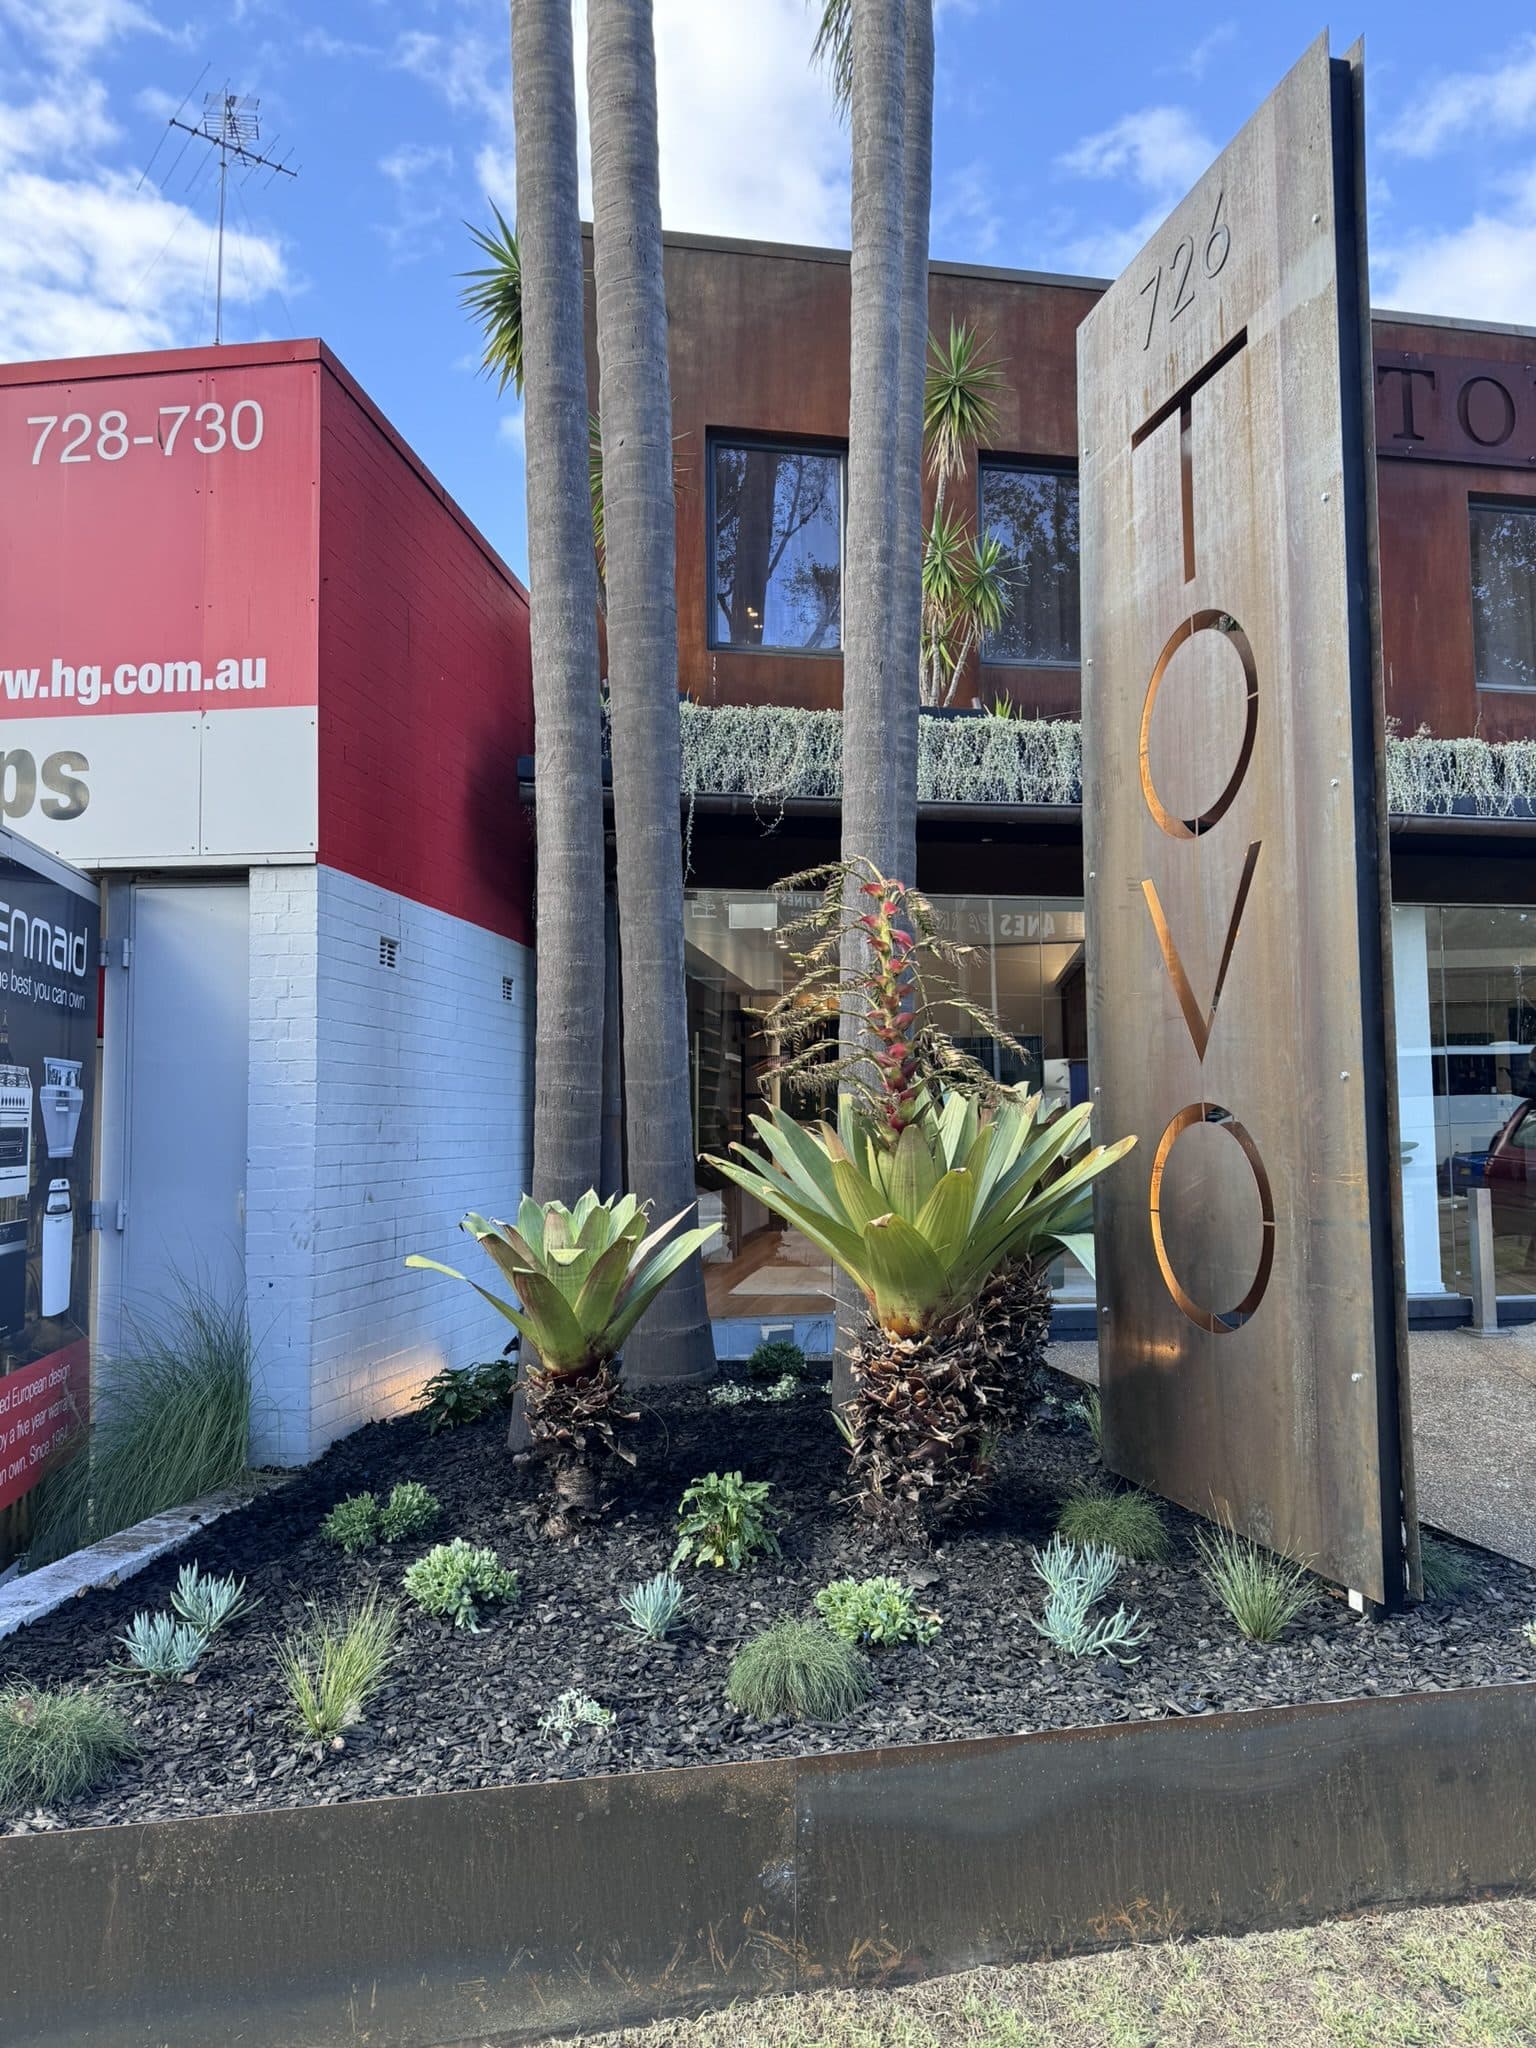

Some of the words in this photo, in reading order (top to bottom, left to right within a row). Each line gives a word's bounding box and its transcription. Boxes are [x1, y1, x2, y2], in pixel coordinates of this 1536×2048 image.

[1139, 191, 1231, 352] 726
[26, 399, 264, 466] 728-730
[1377, 365, 1536, 448] TO
[1131, 325, 1275, 1334] TOVO
[10, 967, 32, 996] best
[33, 980, 51, 1003] you
[51, 985, 69, 1006] can
[68, 991, 86, 1011] own
[11, 1375, 48, 1408] European
[31, 1408, 48, 1436] year
[29, 1439, 50, 1466] Since
